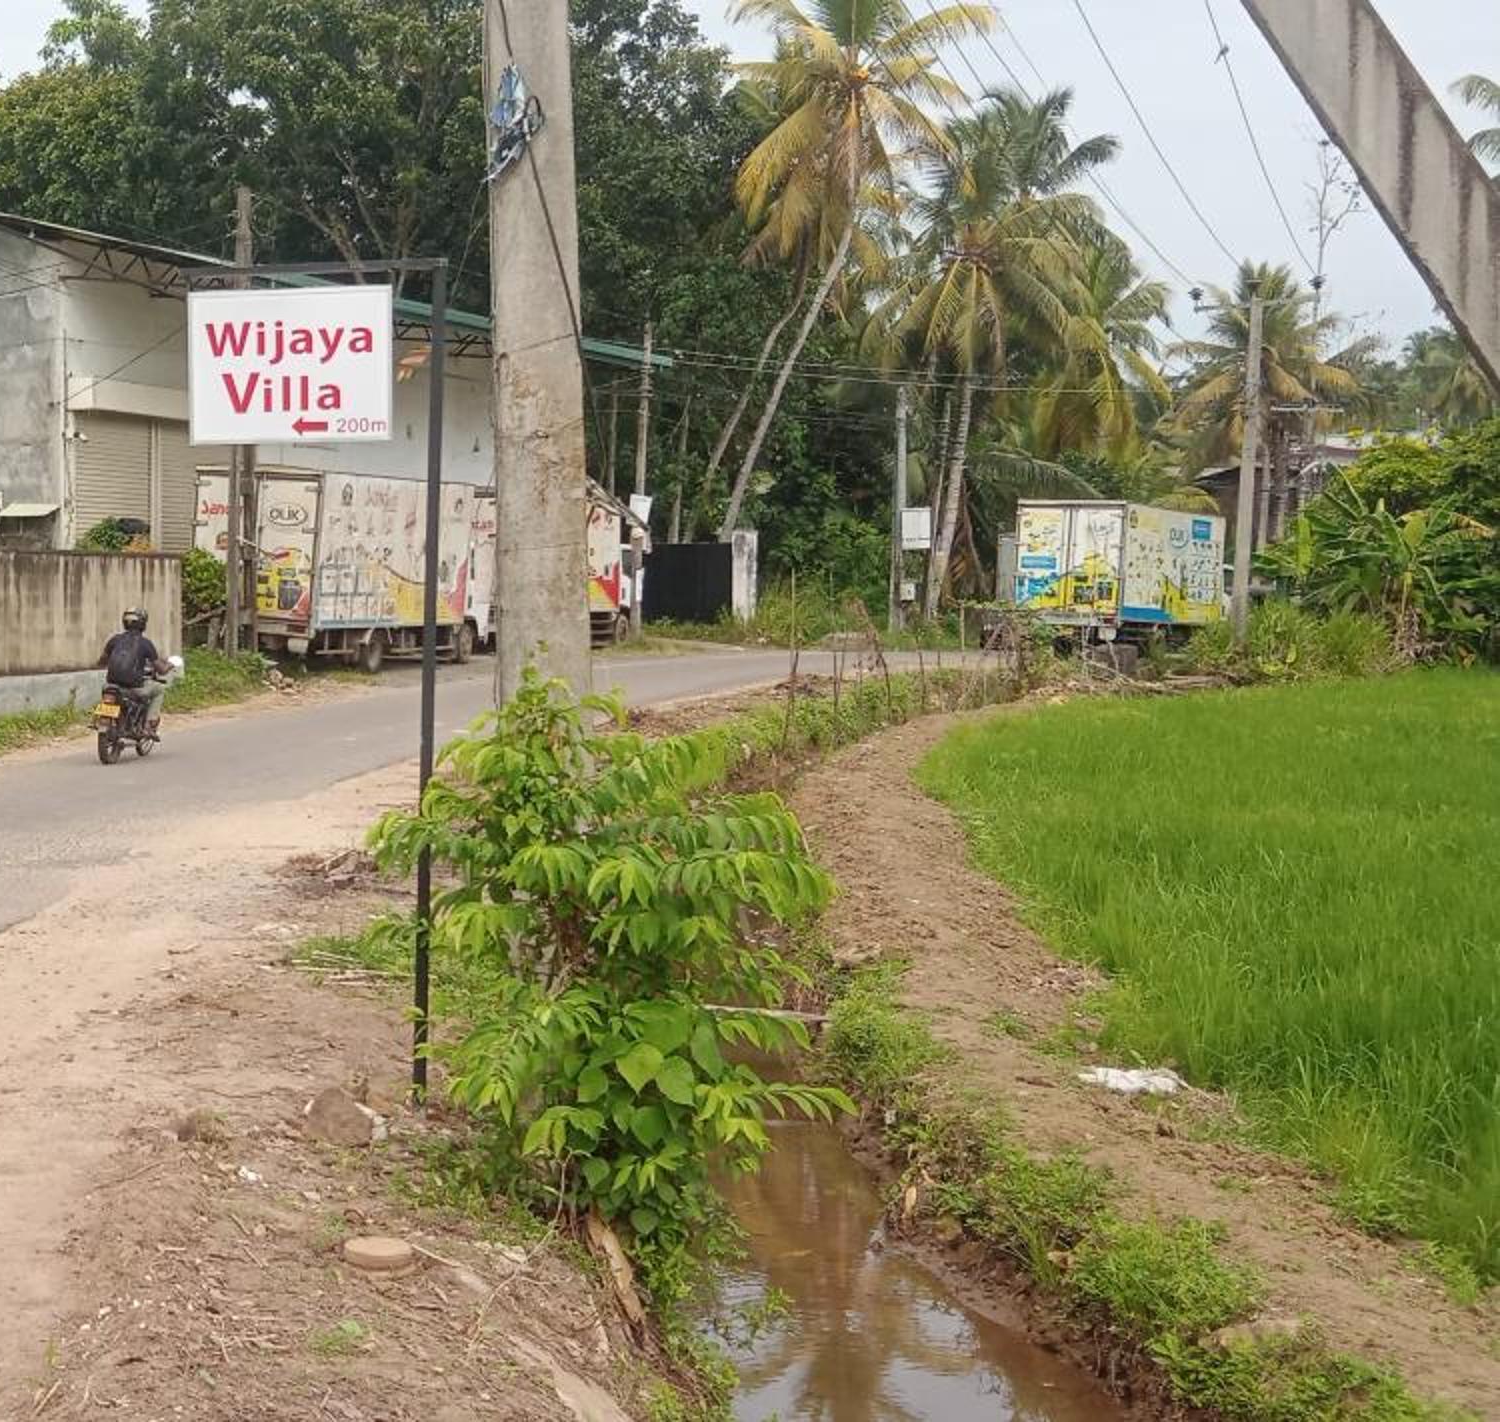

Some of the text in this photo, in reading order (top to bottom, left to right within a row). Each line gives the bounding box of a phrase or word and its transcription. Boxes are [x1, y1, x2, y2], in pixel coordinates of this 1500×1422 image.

[205, 321, 373, 365] Wijaya
[222, 372, 342, 414] Villa
[336, 417, 387, 433] 200m
